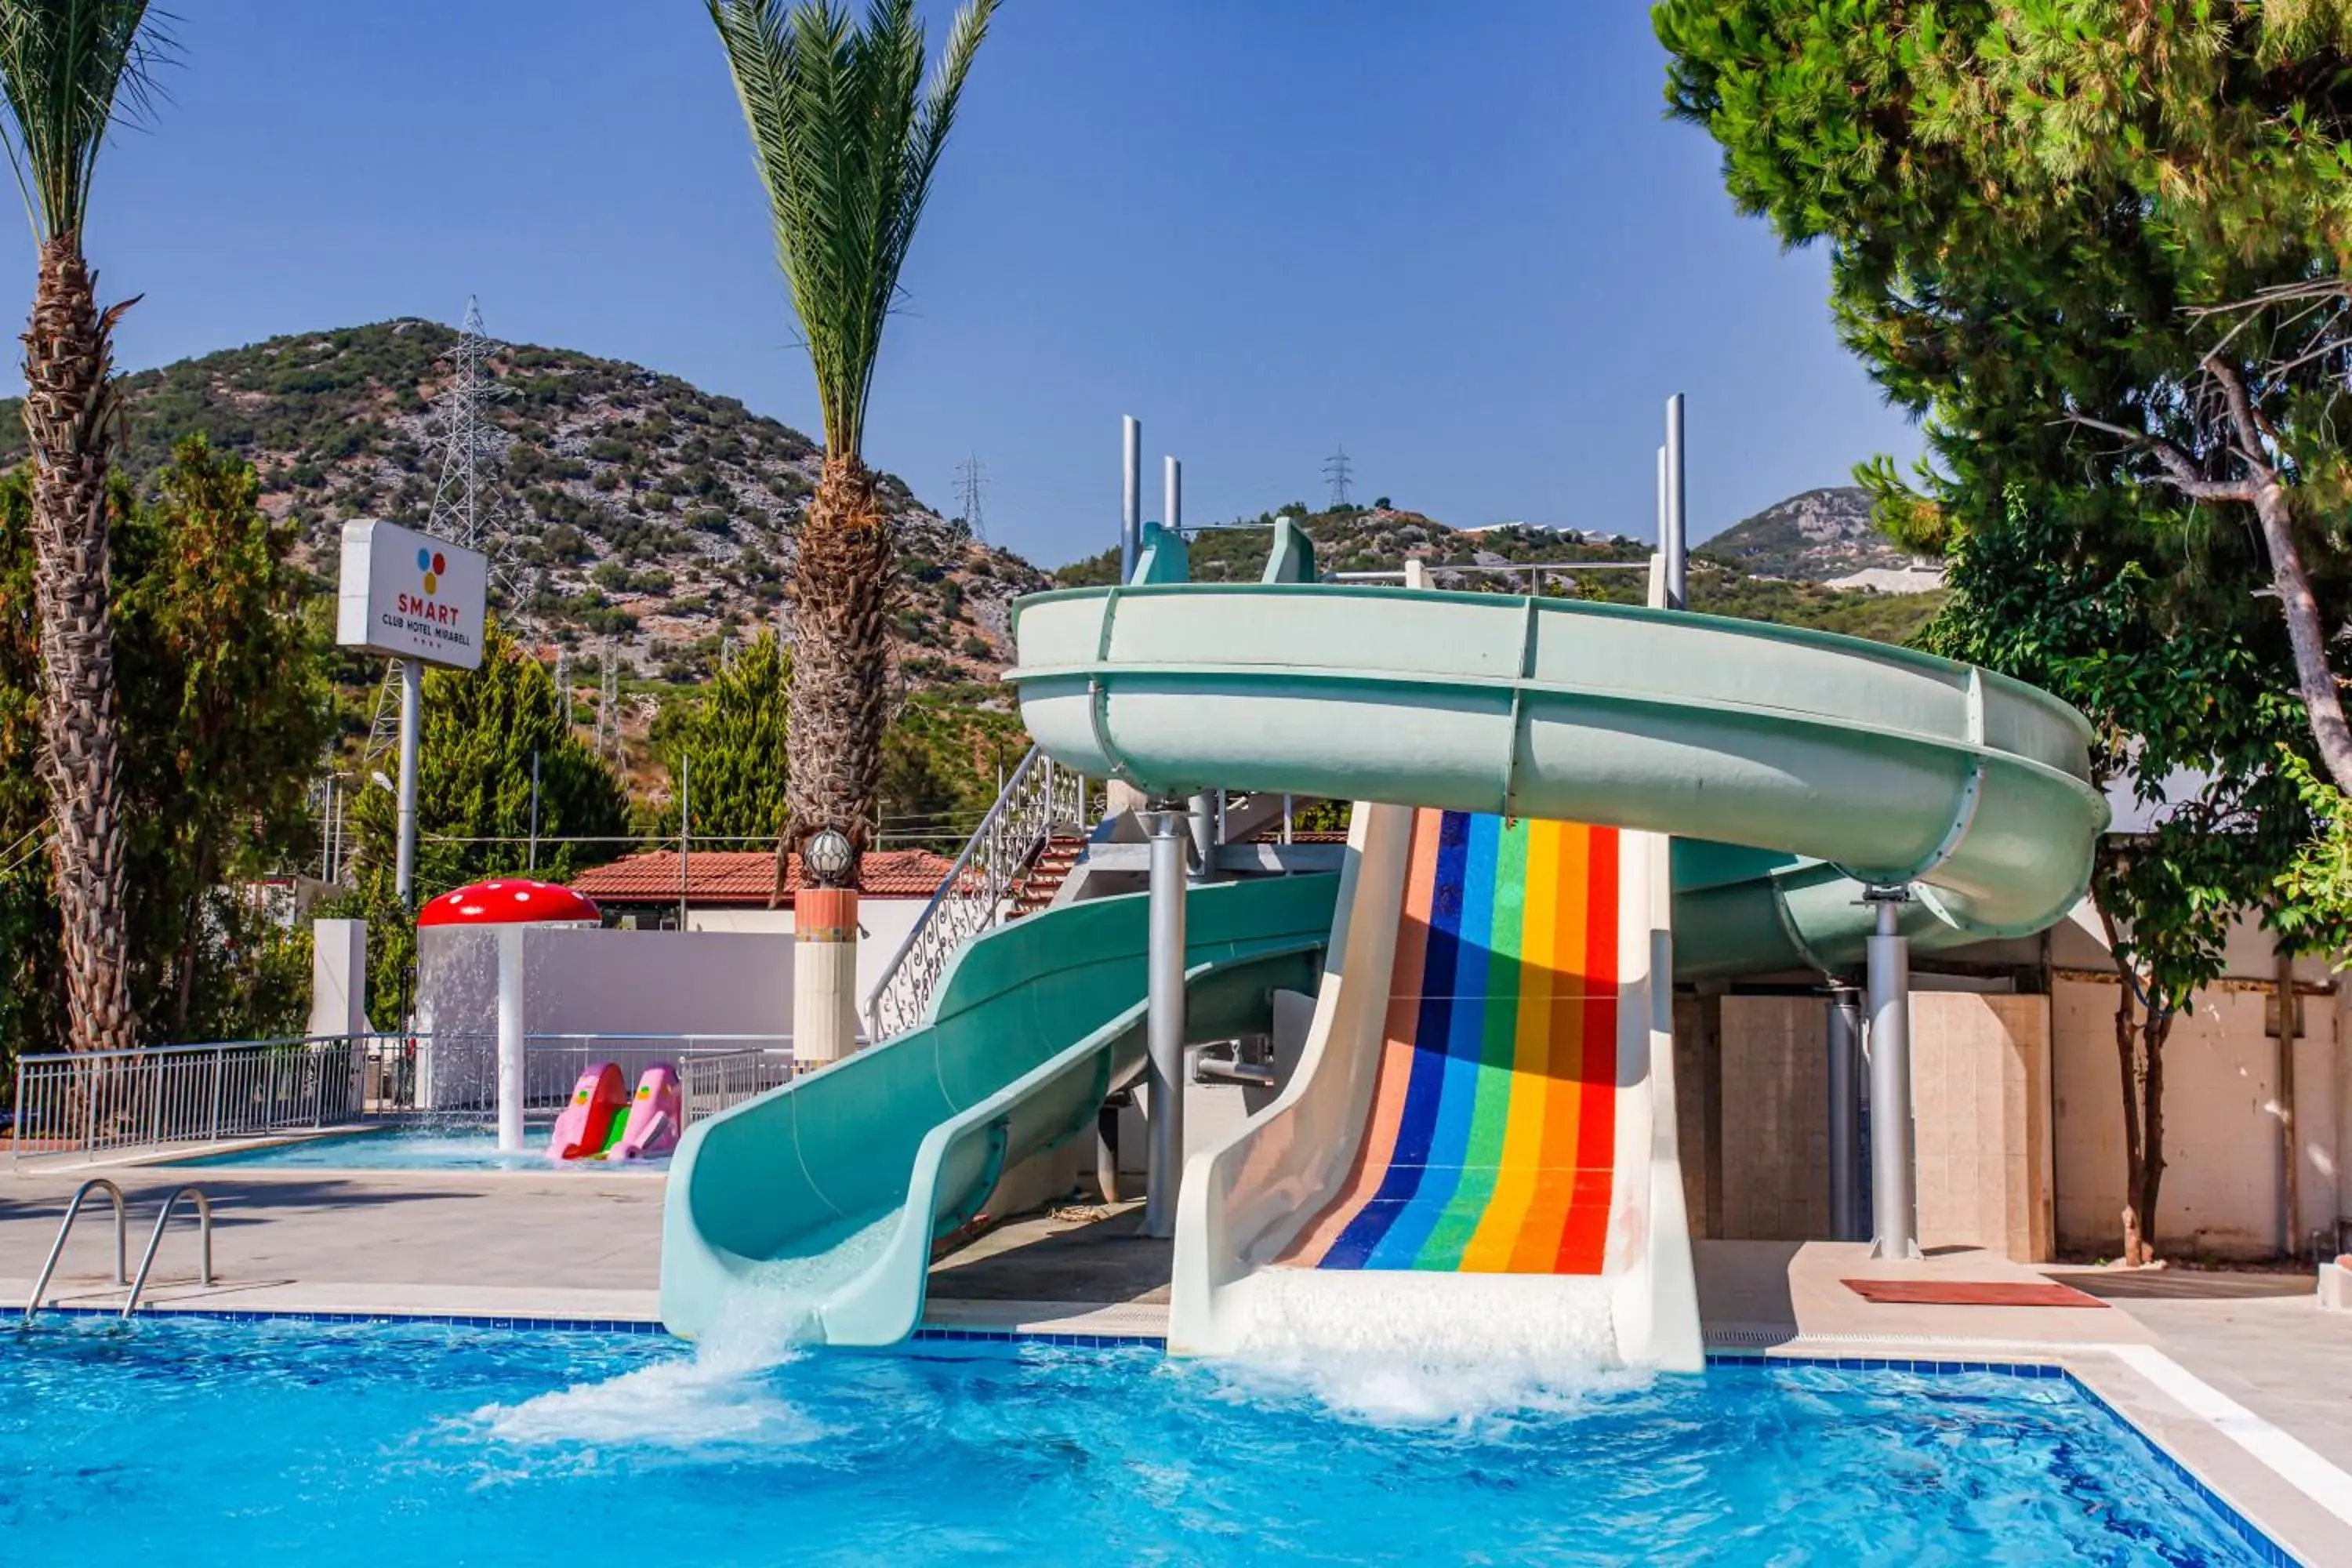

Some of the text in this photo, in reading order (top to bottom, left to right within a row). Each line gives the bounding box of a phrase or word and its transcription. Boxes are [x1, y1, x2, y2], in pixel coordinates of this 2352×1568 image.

[398, 593, 459, 626] SMART
[382, 614, 470, 646] CLUB HOTEL MIRABELL
